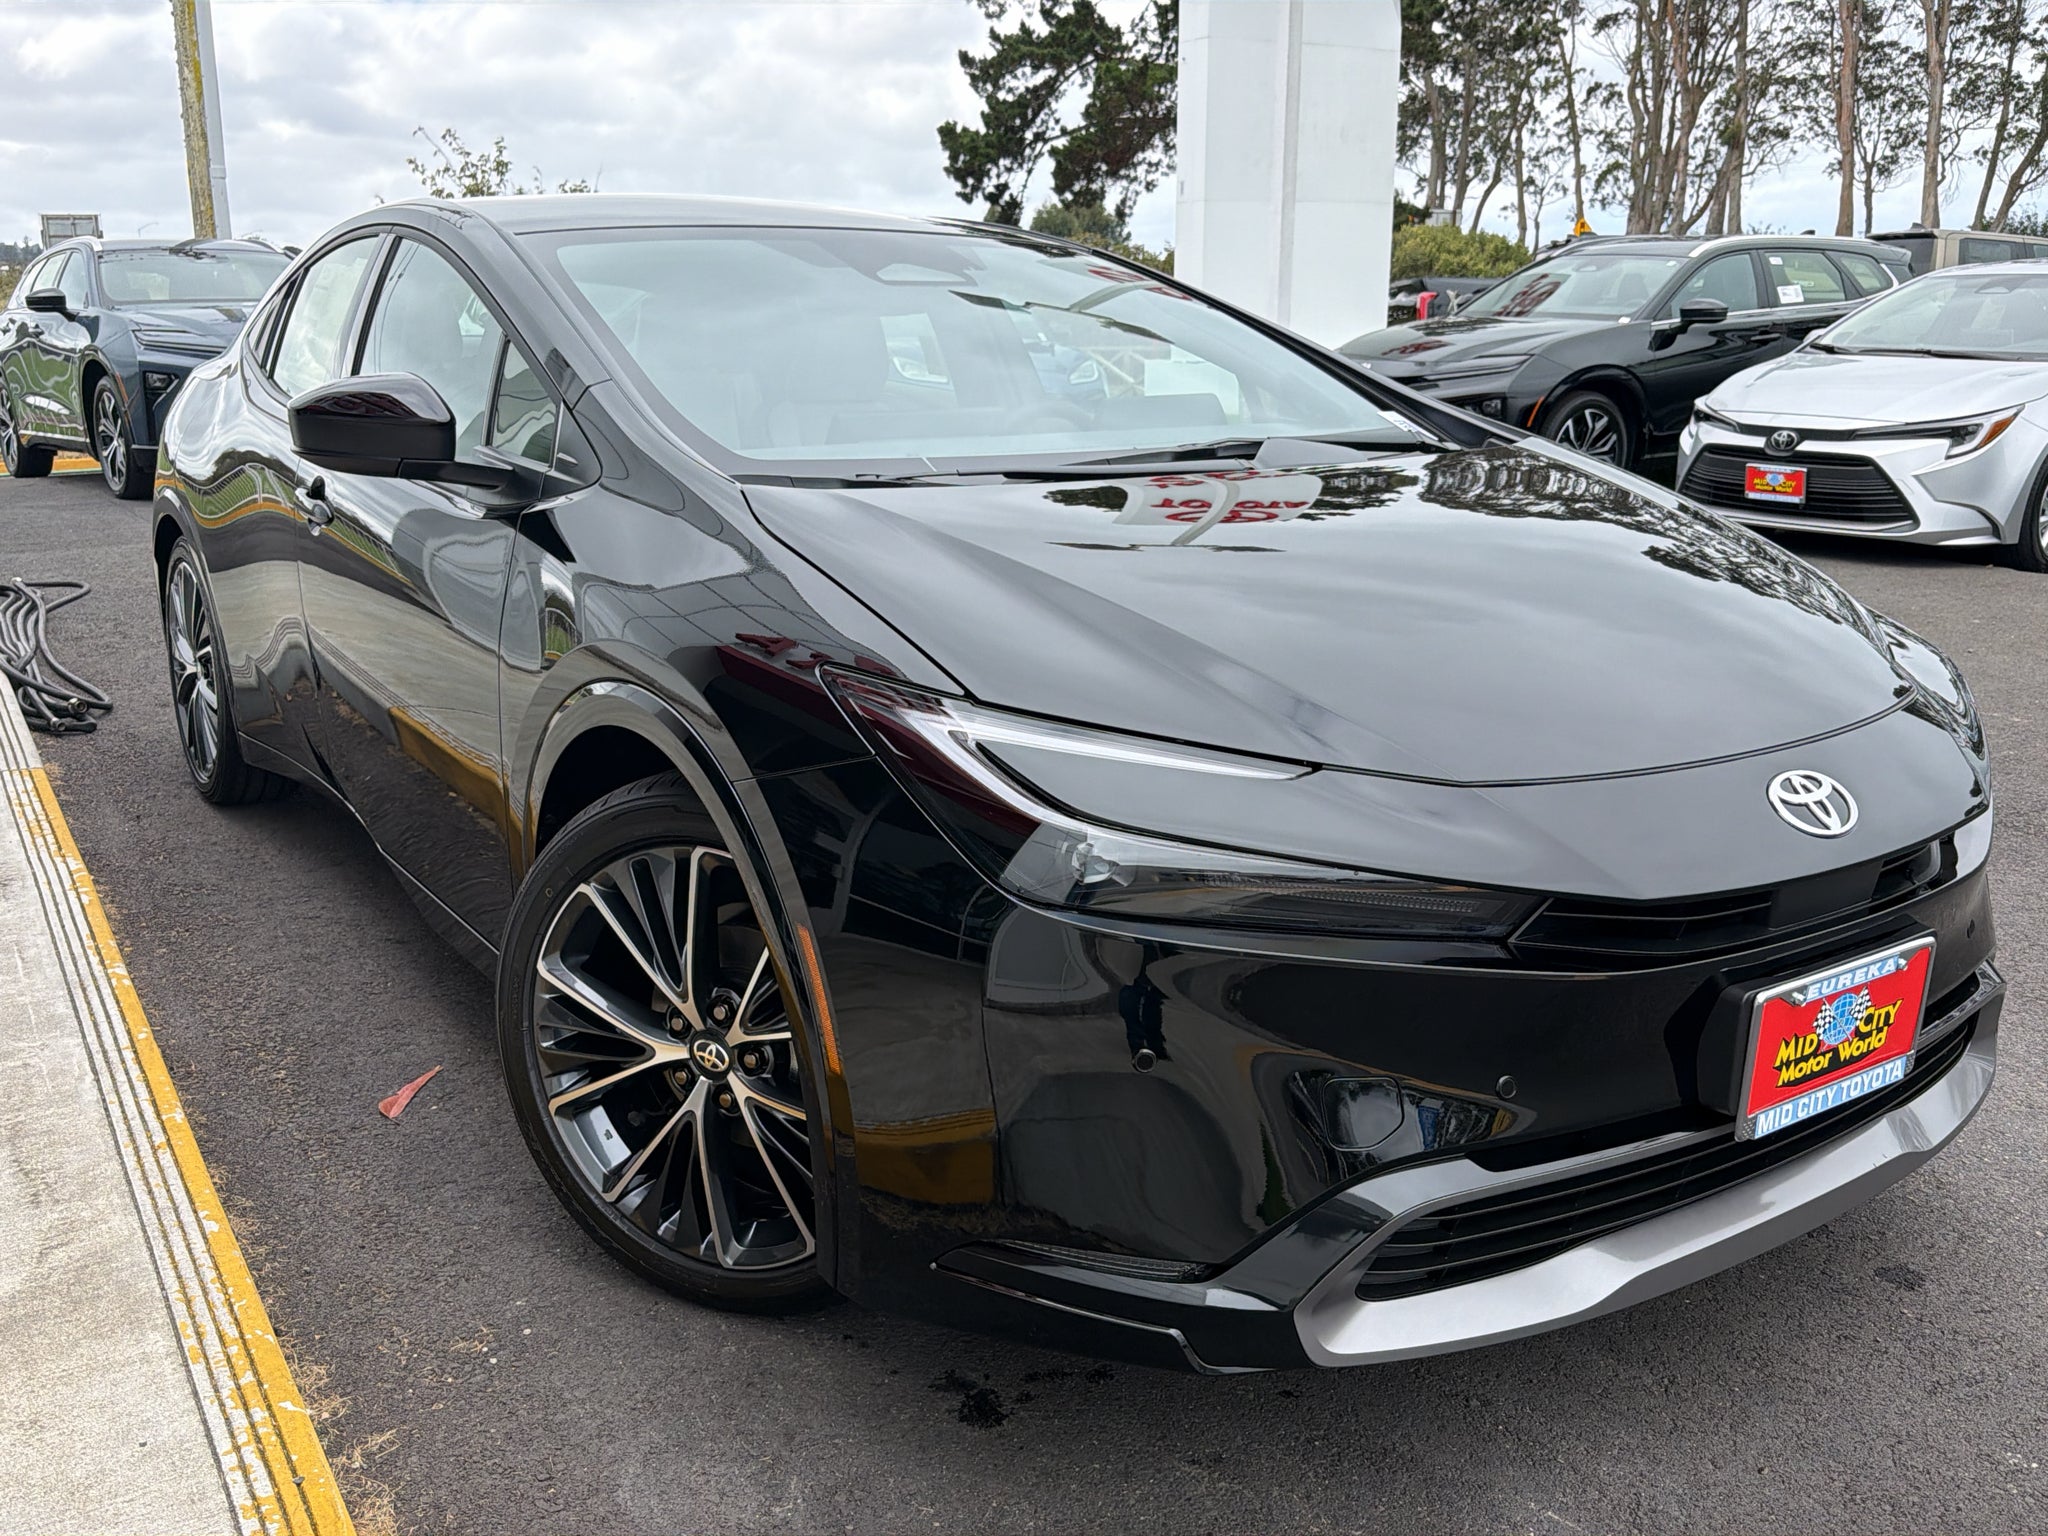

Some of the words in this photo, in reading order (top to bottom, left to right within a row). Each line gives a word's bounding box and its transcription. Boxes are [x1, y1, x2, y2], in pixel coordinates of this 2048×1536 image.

[1806, 958, 1896, 999] EUREKA
[1774, 1033, 1819, 1068] MID
[1859, 1000, 1903, 1033] CITY
[1777, 1051, 1833, 1087] Motor
[1837, 1026, 1888, 1062] World
[1757, 1104, 1794, 1135] MID
[1797, 1086, 1838, 1117] CITY
[1841, 1061, 1903, 1101] TOYOTA
